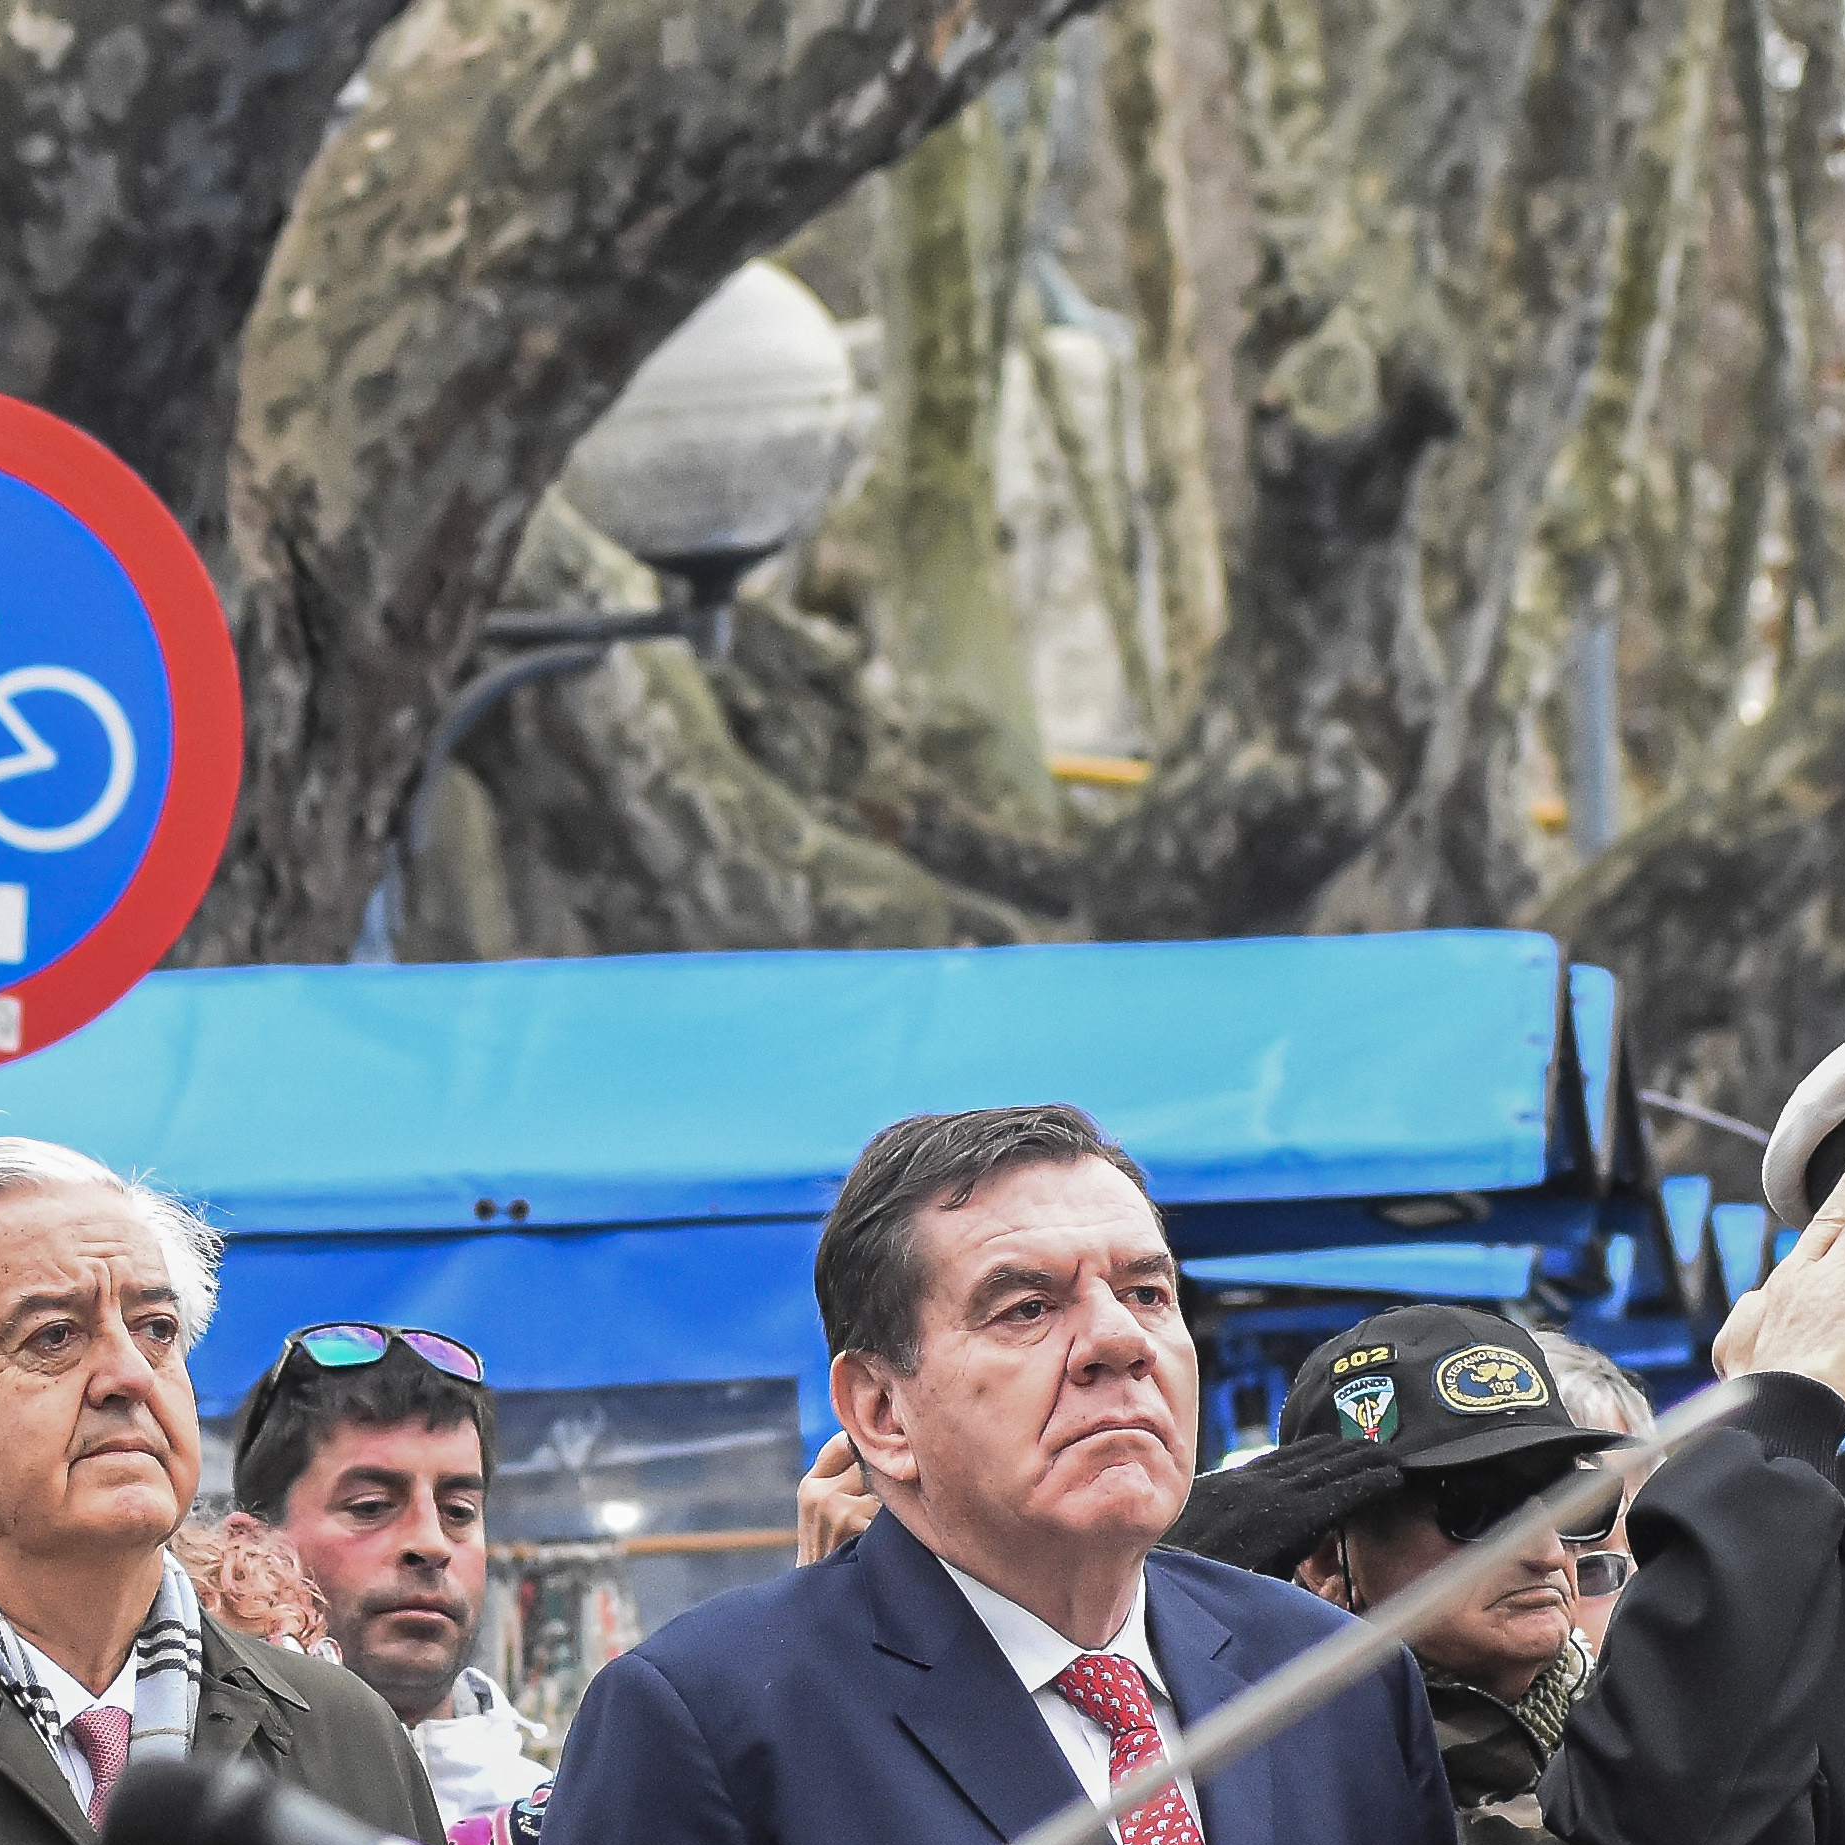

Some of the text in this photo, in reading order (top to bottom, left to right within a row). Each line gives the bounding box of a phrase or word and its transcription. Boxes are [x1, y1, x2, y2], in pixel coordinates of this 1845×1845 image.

[1333, 1346, 1389, 1374] 602
[1445, 1351, 1487, 1392] VETERANO
[1337, 1378, 1388, 1400] COMANDO
[1488, 1381, 1520, 1394] 1982
